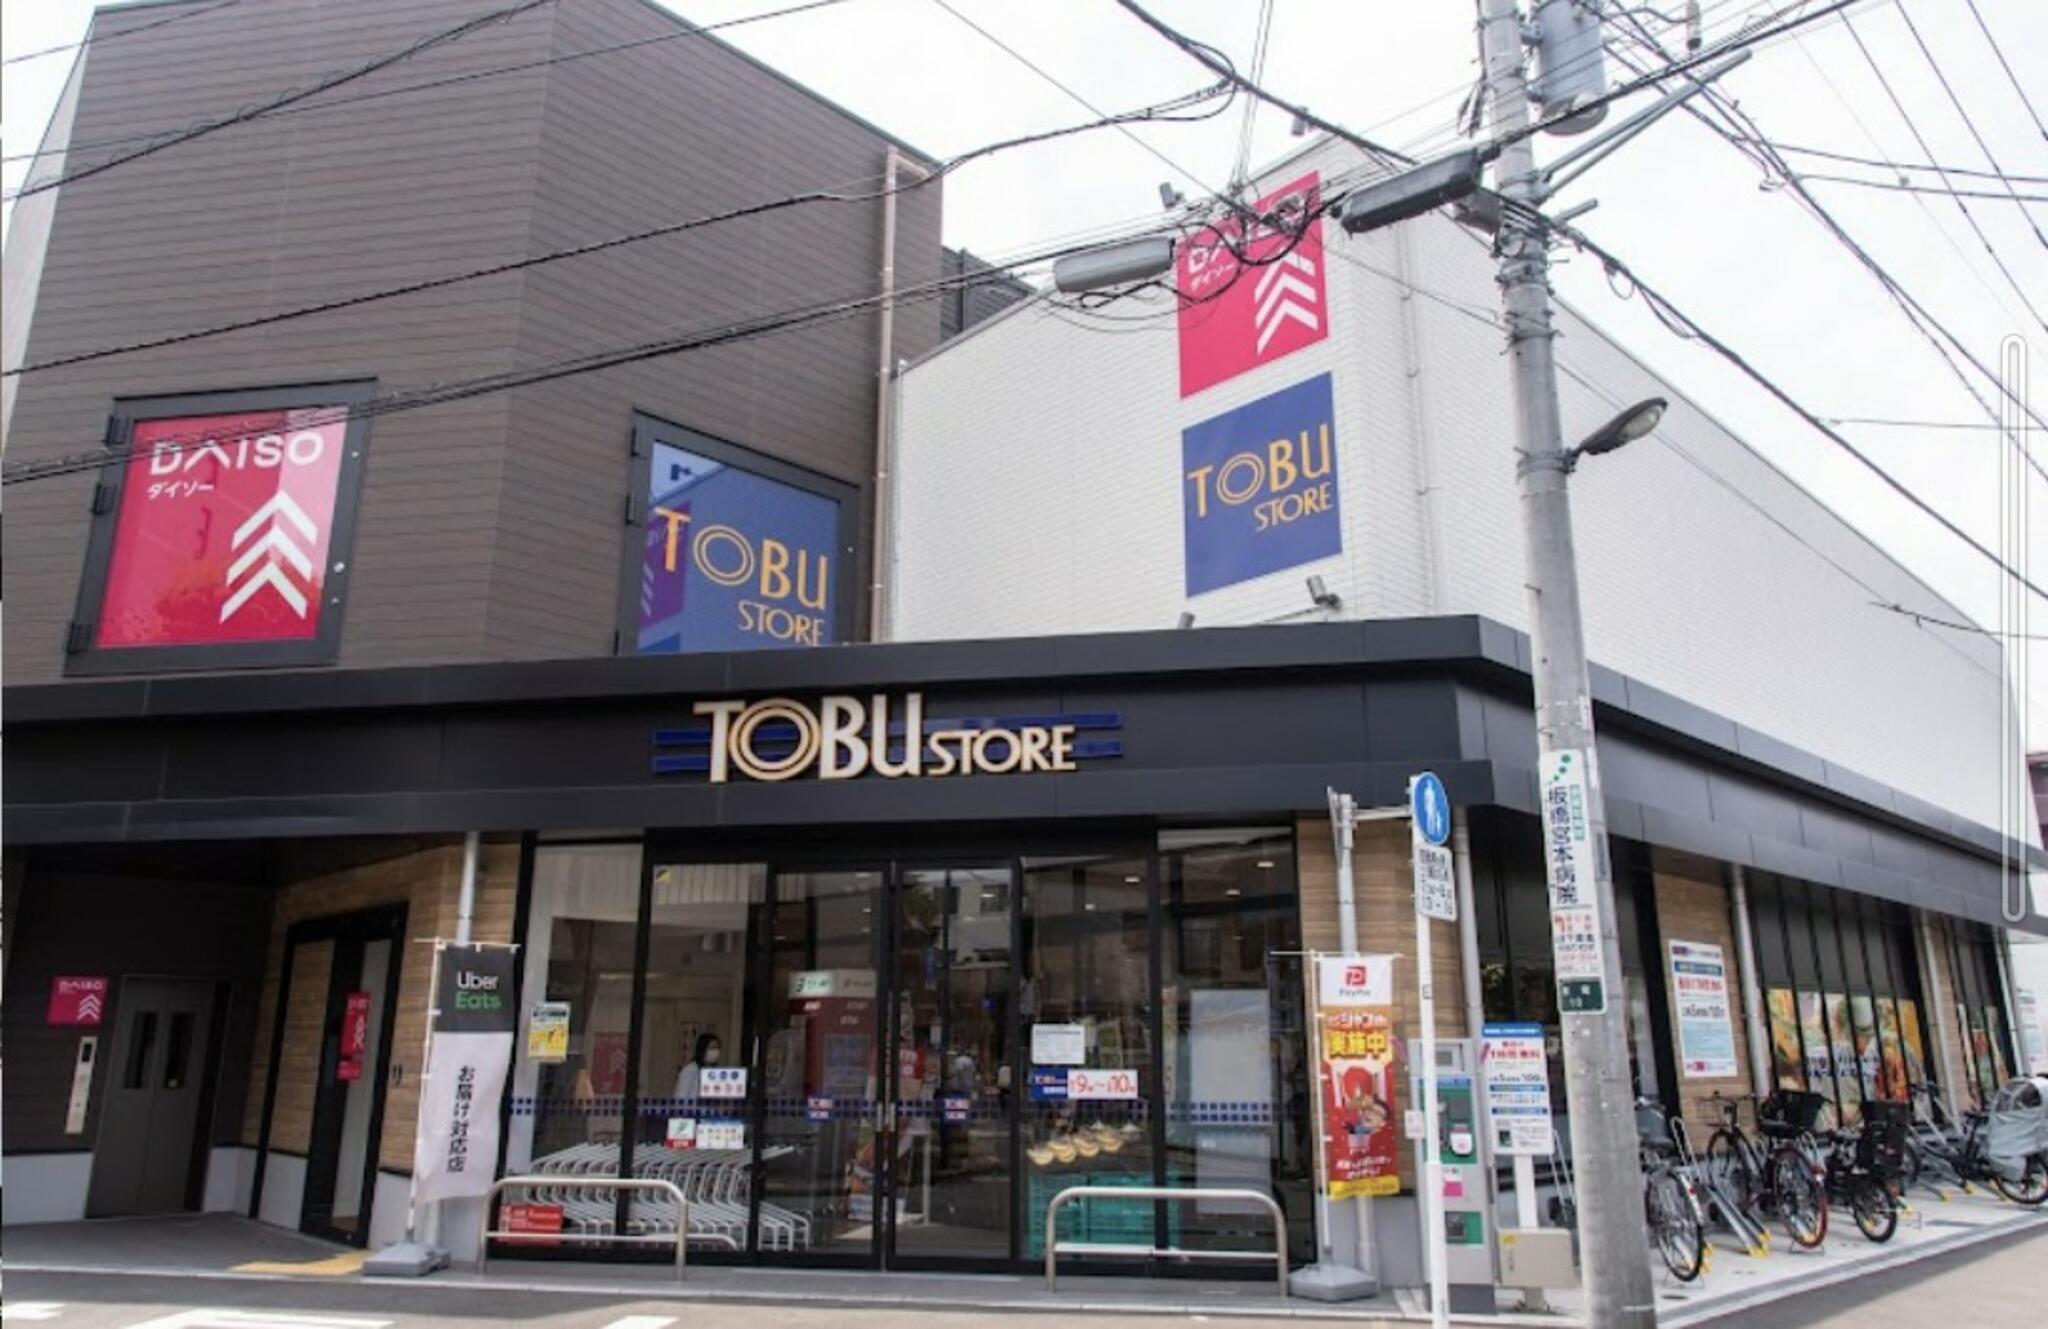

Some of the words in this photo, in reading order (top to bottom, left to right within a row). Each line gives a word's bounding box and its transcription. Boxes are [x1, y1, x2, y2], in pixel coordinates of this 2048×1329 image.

[150, 432, 324, 476] DAISO
[1187, 423, 1331, 518] TOBU
[146, 480, 214, 500] ダイソー
[1253, 481, 1333, 533] STORE
[653, 506, 828, 611] TOBU
[737, 599, 825, 646] STORE
[693, 693, 922, 783] TOBU
[928, 725, 1077, 775] STORE
[456, 992, 502, 1009] Eats
[457, 970, 499, 991] Uber
